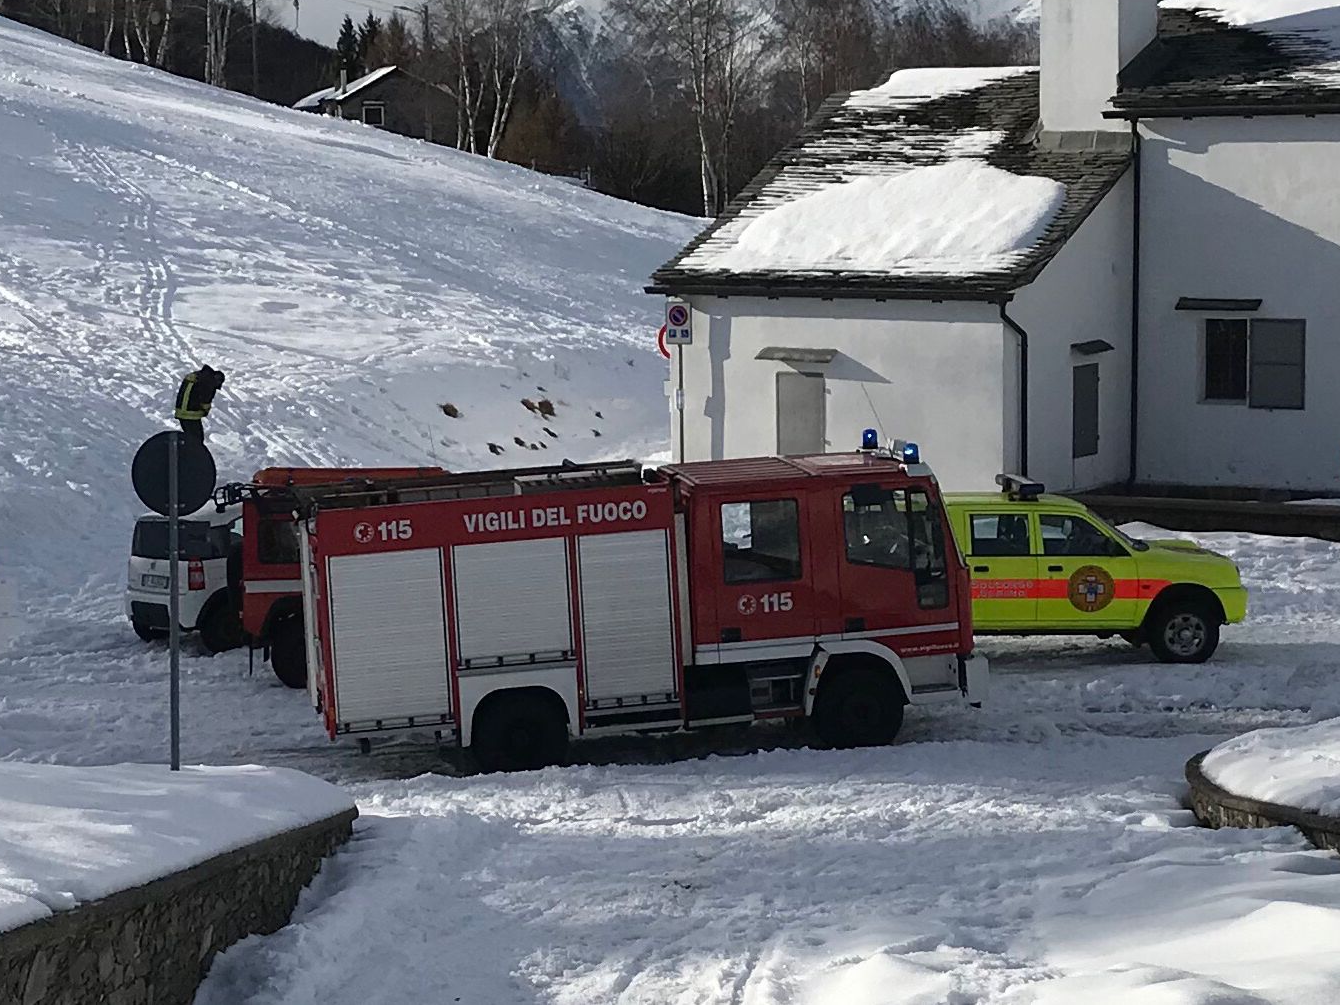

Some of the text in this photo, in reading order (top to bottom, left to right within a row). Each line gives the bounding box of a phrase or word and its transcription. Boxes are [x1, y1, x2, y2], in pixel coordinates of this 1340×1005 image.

[463, 500, 647, 533] VIGILI DEL FUOCO
[377, 519, 413, 541] 115
[760, 592, 793, 613] 115
